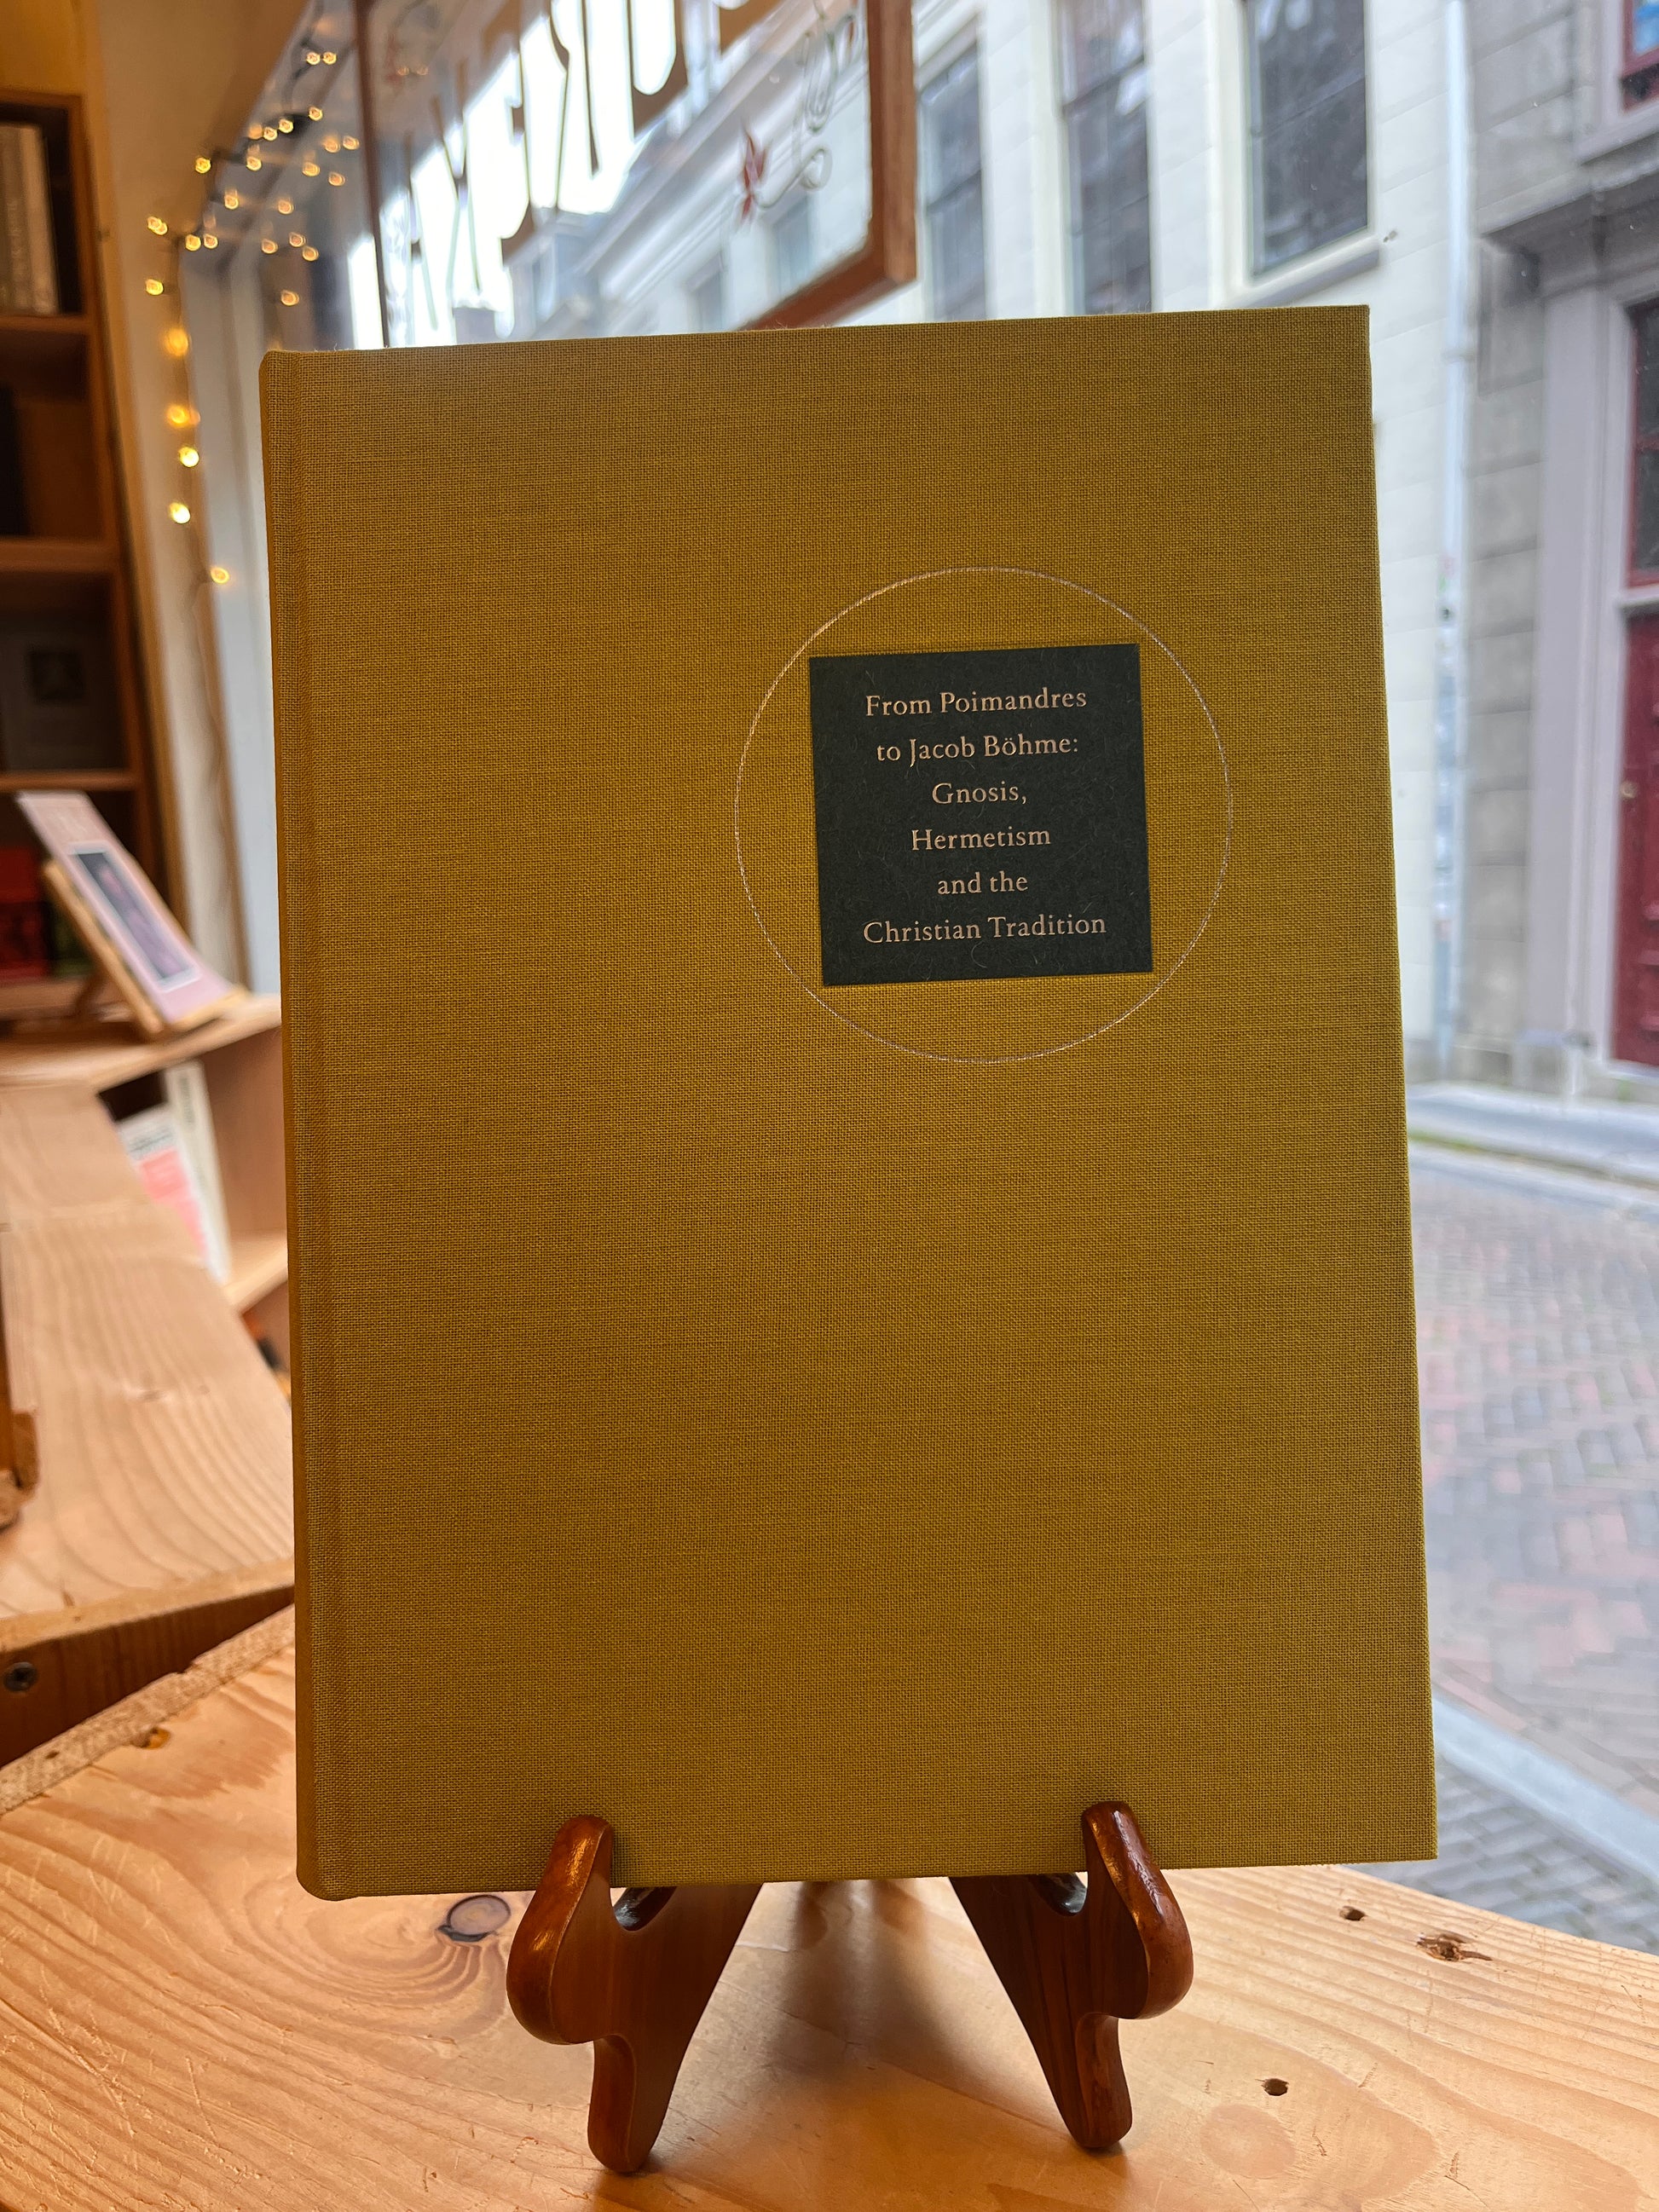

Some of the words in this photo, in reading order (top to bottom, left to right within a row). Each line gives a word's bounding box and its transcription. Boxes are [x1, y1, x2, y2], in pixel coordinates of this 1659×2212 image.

[866, 695, 932, 716] From
[939, 687, 1087, 713] Poimandres
[876, 744, 901, 761] to
[909, 736, 975, 766] Jacob
[984, 734, 1078, 756] Böhme:
[932, 781, 1027, 805] Gnosis,
[911, 826, 1051, 850] Hermetism
[938, 872, 982, 894] and
[990, 871, 1028, 892] the
[863, 920, 981, 943] Christian
[988, 915, 1107, 939] Tradition
